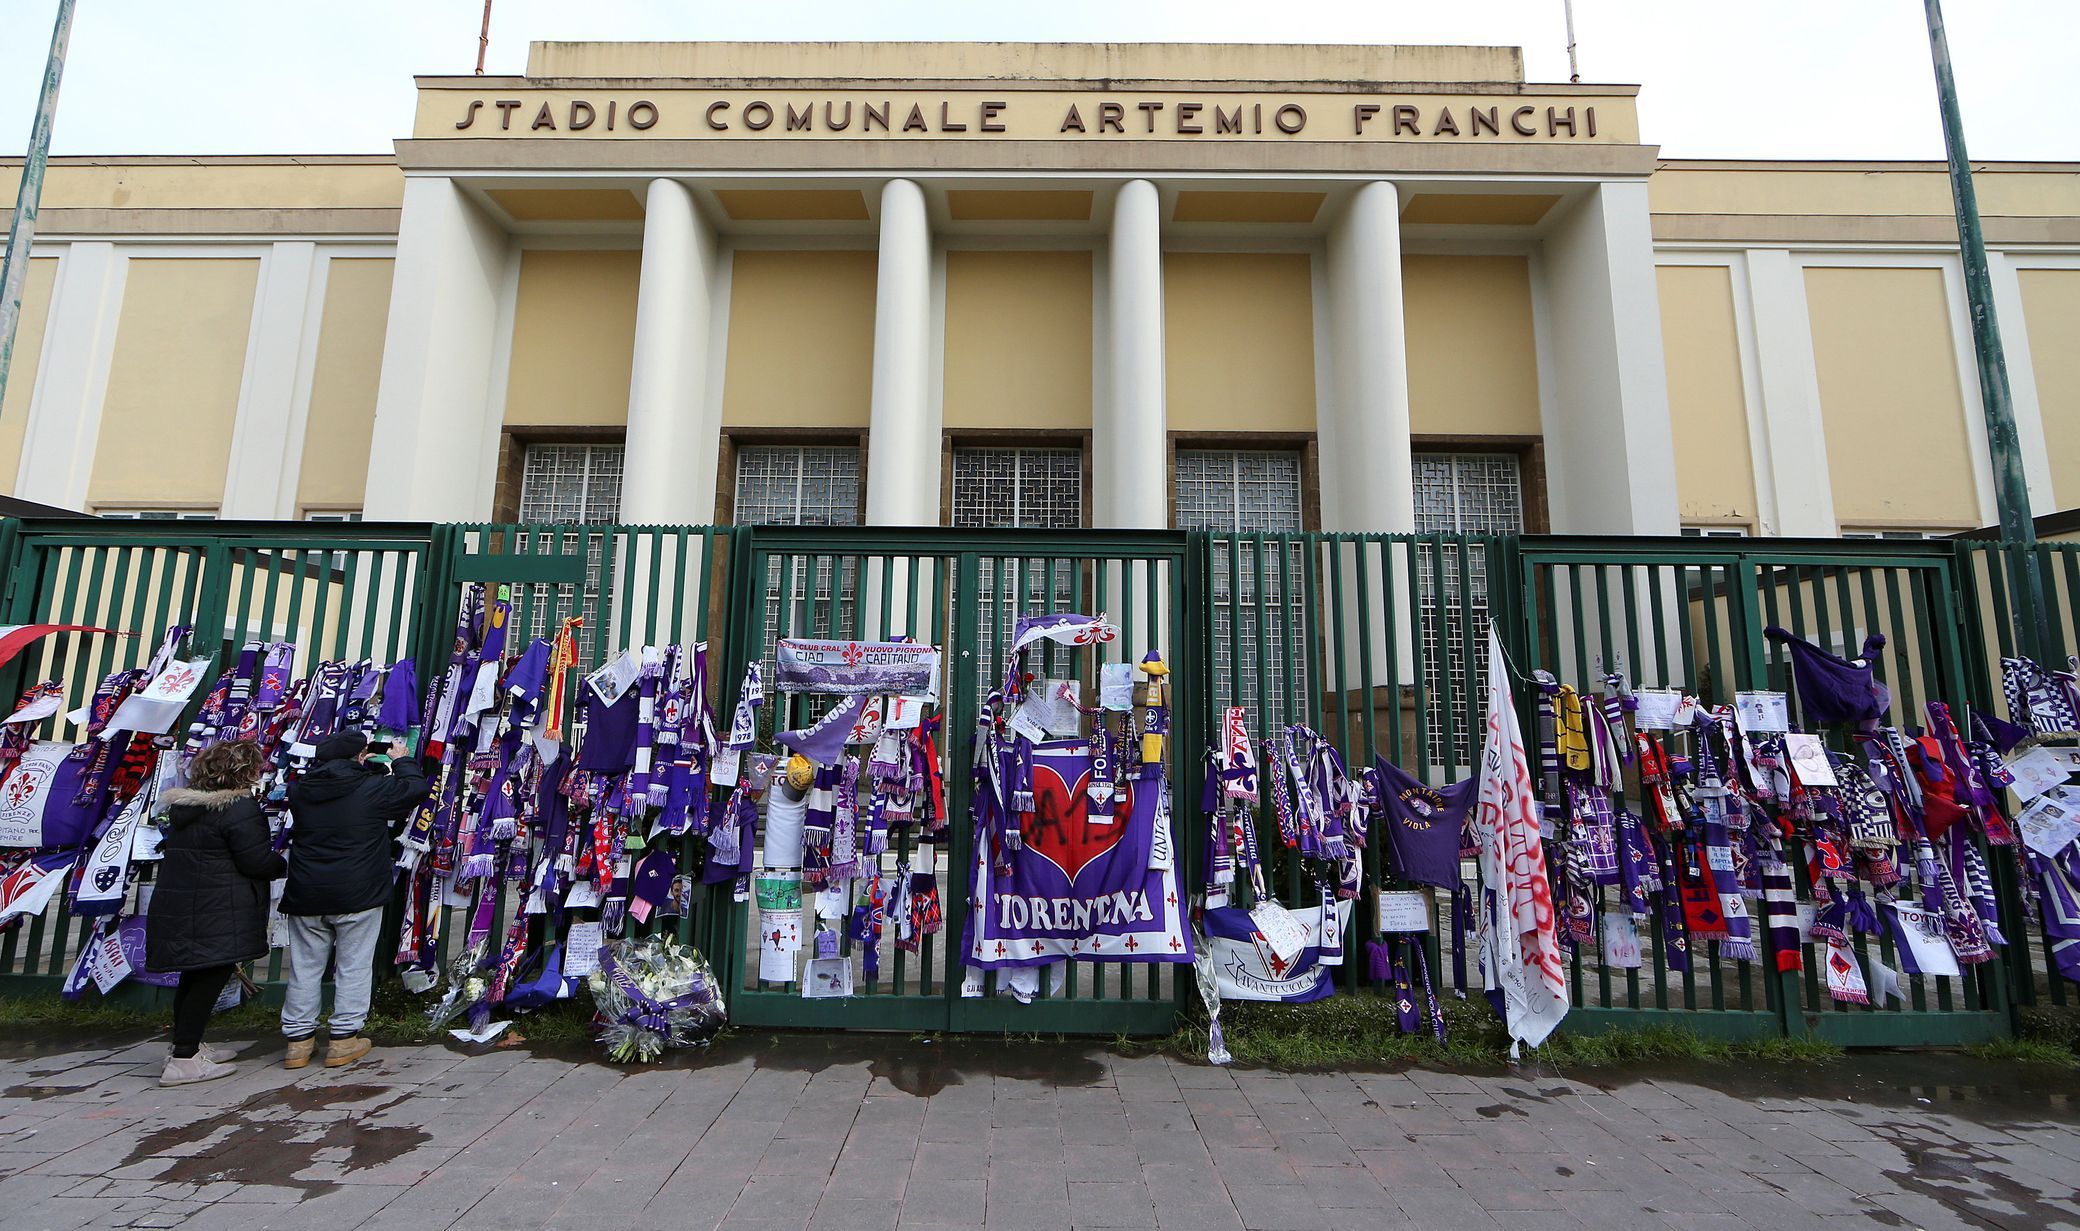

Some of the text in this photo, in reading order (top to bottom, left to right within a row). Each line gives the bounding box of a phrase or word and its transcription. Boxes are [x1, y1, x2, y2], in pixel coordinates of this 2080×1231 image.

[456, 100, 1598, 138] STADIO COMUNALE ARTEMIO FRANCHI
[798, 643, 820, 652] CLUB
[821, 644, 841, 652] CRAL
[795, 651, 919, 665] CIAO CAPITANO
[1403, 817, 1431, 830] VIOLA
[103, 938, 125, 967] ASTORI
